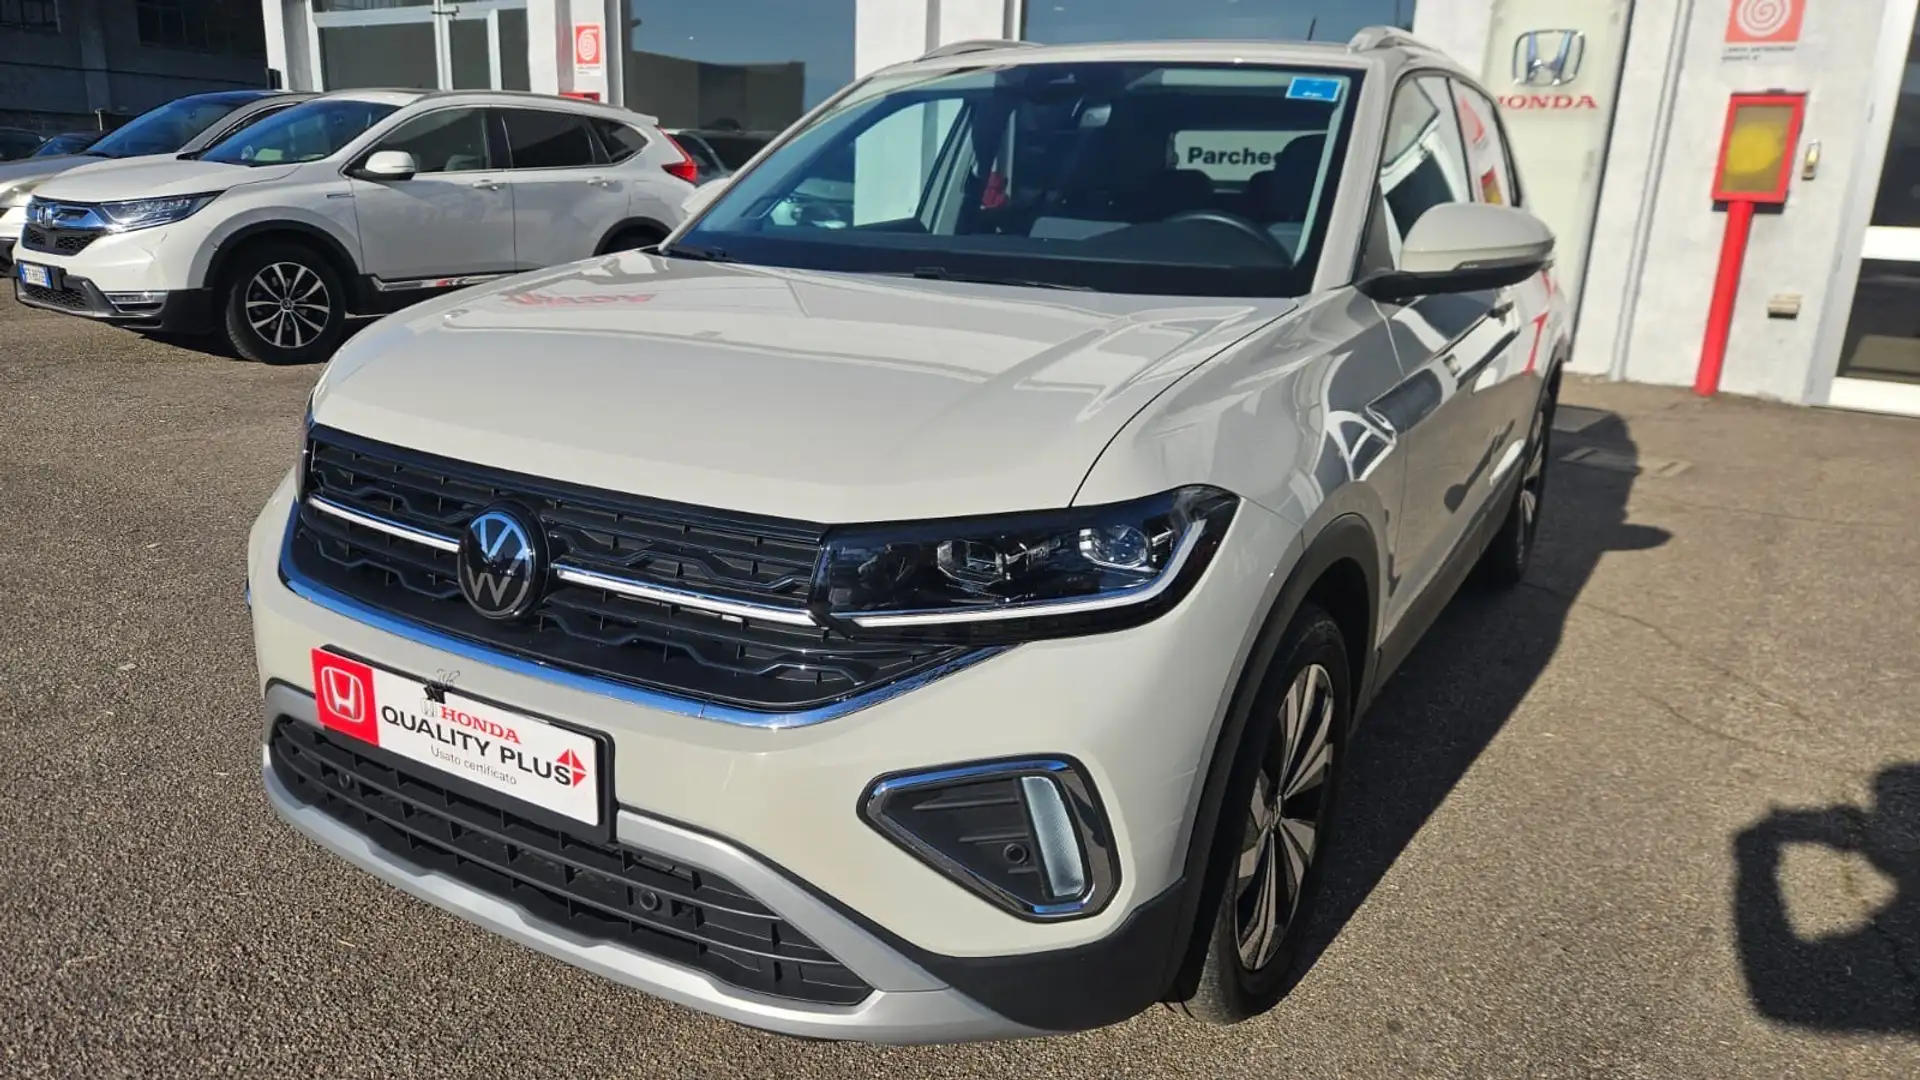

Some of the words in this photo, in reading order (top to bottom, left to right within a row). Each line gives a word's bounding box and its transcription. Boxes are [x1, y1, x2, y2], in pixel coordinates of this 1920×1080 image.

[1187, 147, 1281, 165] Parche
[441, 705, 521, 744] HONDA
[381, 705, 490, 757] QUALITY
[500, 745, 571, 786] PLUS
[430, 744, 461, 766] Usato
[464, 759, 517, 785] certificato
